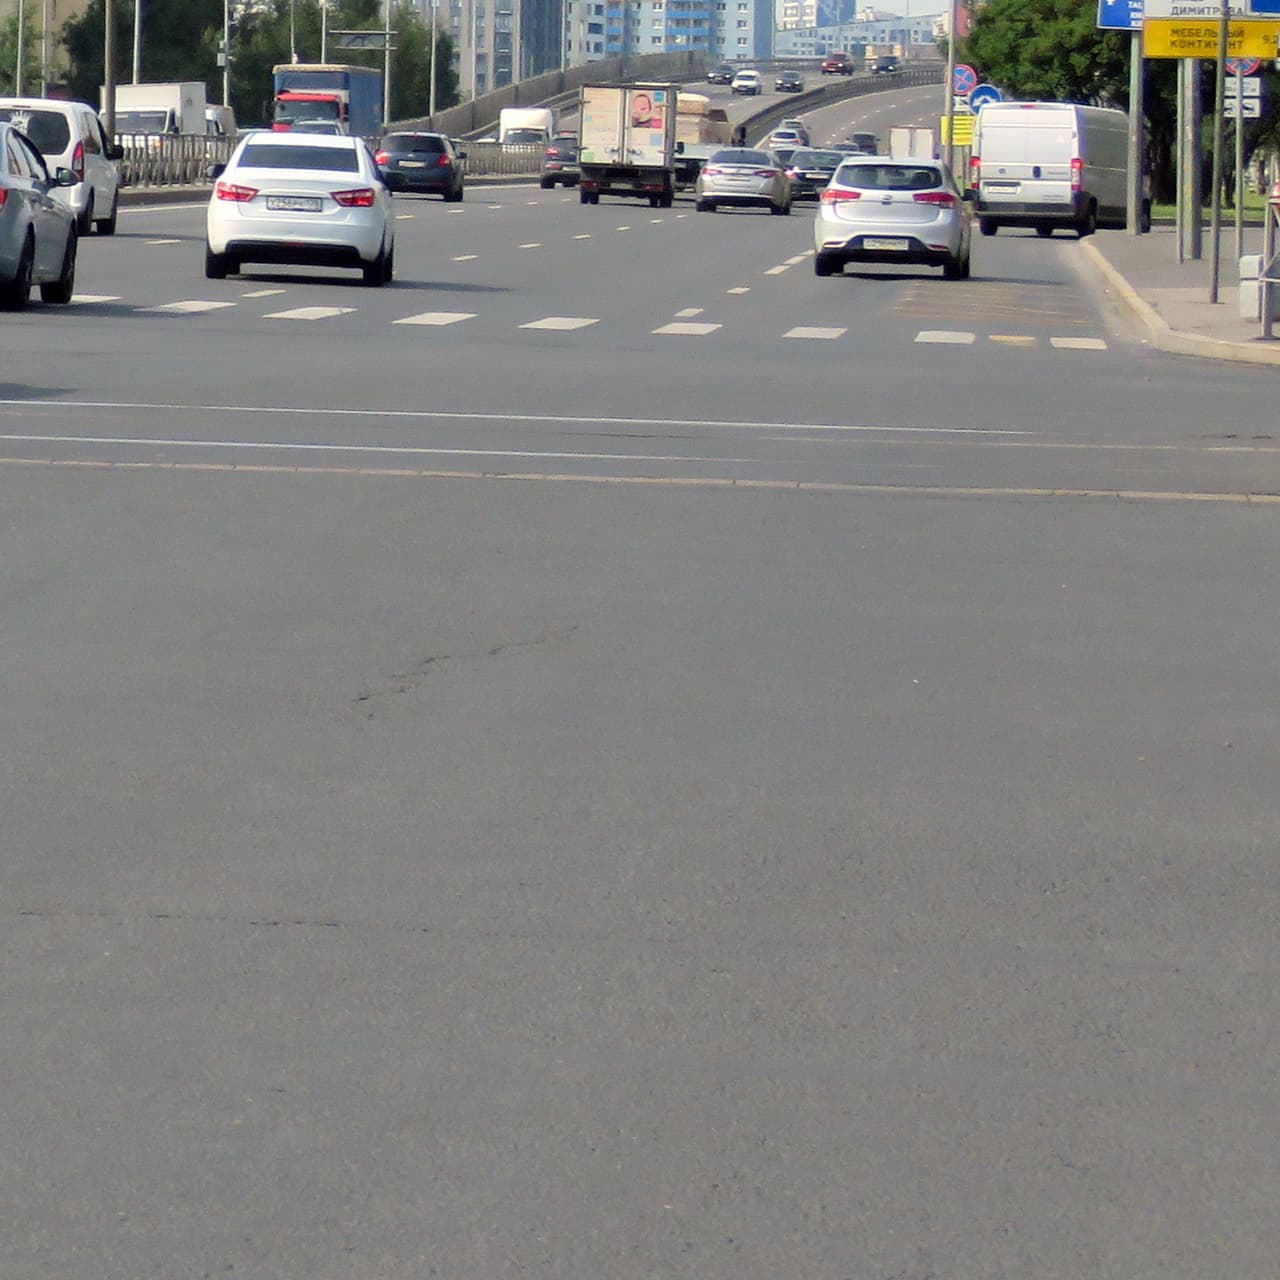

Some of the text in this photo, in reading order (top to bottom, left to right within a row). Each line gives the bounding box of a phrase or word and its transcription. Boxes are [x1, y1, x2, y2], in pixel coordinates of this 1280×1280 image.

[1171, 6, 1244, 17] ДИМИТРВА
[1170, 27, 1244, 38] МЕБЕЛЬЫЙ
[1170, 39, 1244, 49] КОНТИННТ
